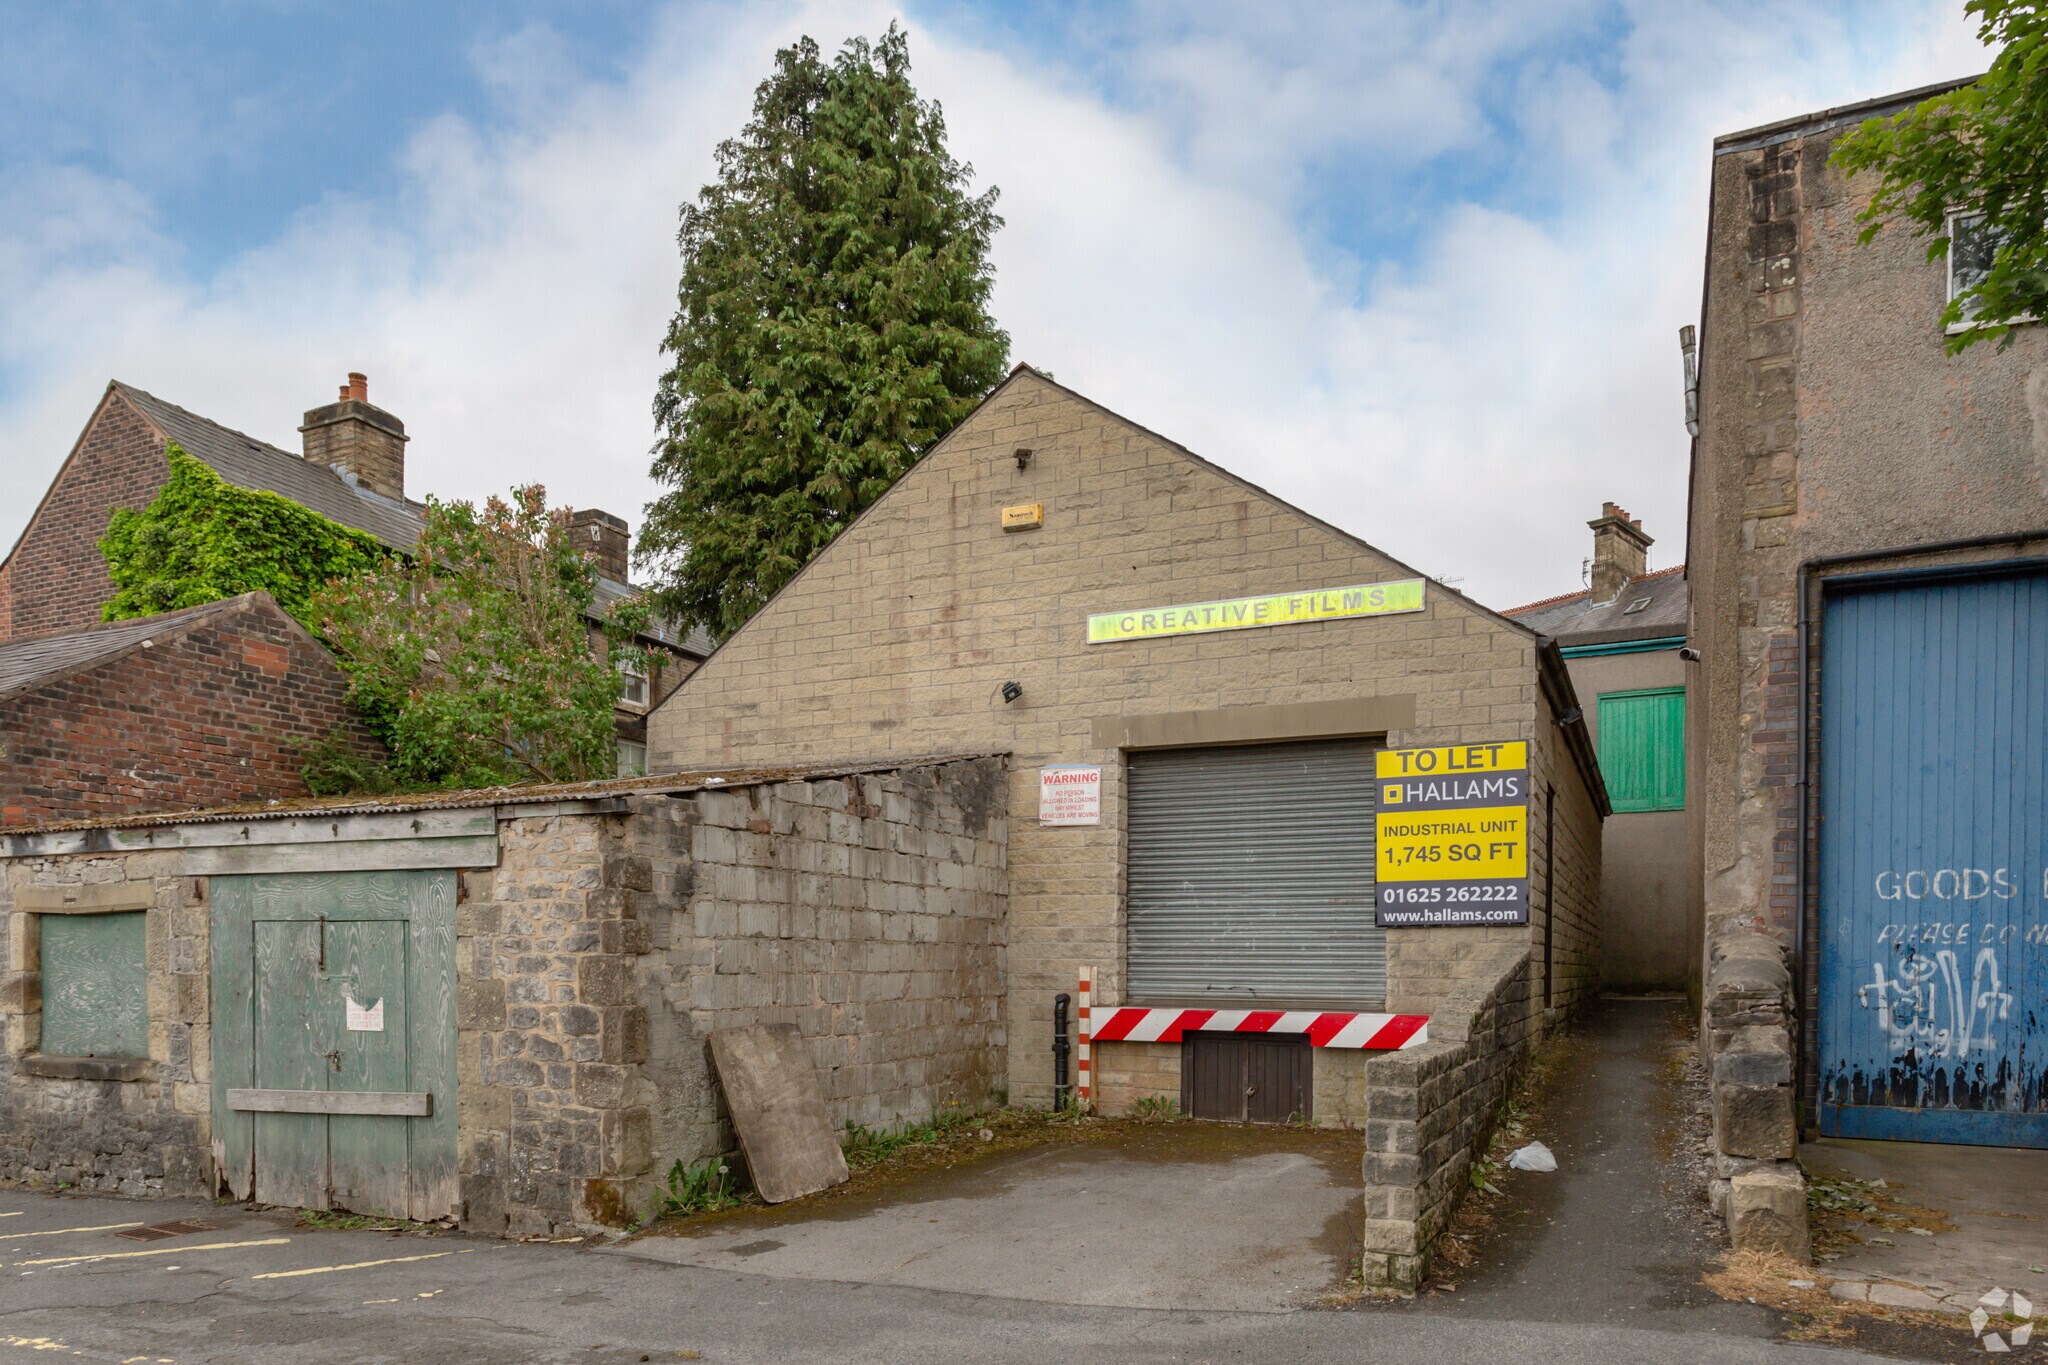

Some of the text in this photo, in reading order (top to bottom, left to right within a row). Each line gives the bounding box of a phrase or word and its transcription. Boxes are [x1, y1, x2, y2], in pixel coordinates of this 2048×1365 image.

[1120, 589, 1385, 633] CREATIVE FILMS
[1396, 745, 1504, 772] TO LET
[1043, 773, 1098, 784] WARNING
[1407, 777, 1518, 803] HALLAMS
[1384, 820, 1518, 837] INDUSTRIAL UNIT
[1385, 842, 1518, 867] 1,745 SQ FT
[1384, 886, 1518, 903] 01625 262222
[1875, 868, 2017, 900] GOODS
[1384, 909, 1518, 922] www.hallams.com
[1877, 922, 2048, 944] PLEASE DO N
